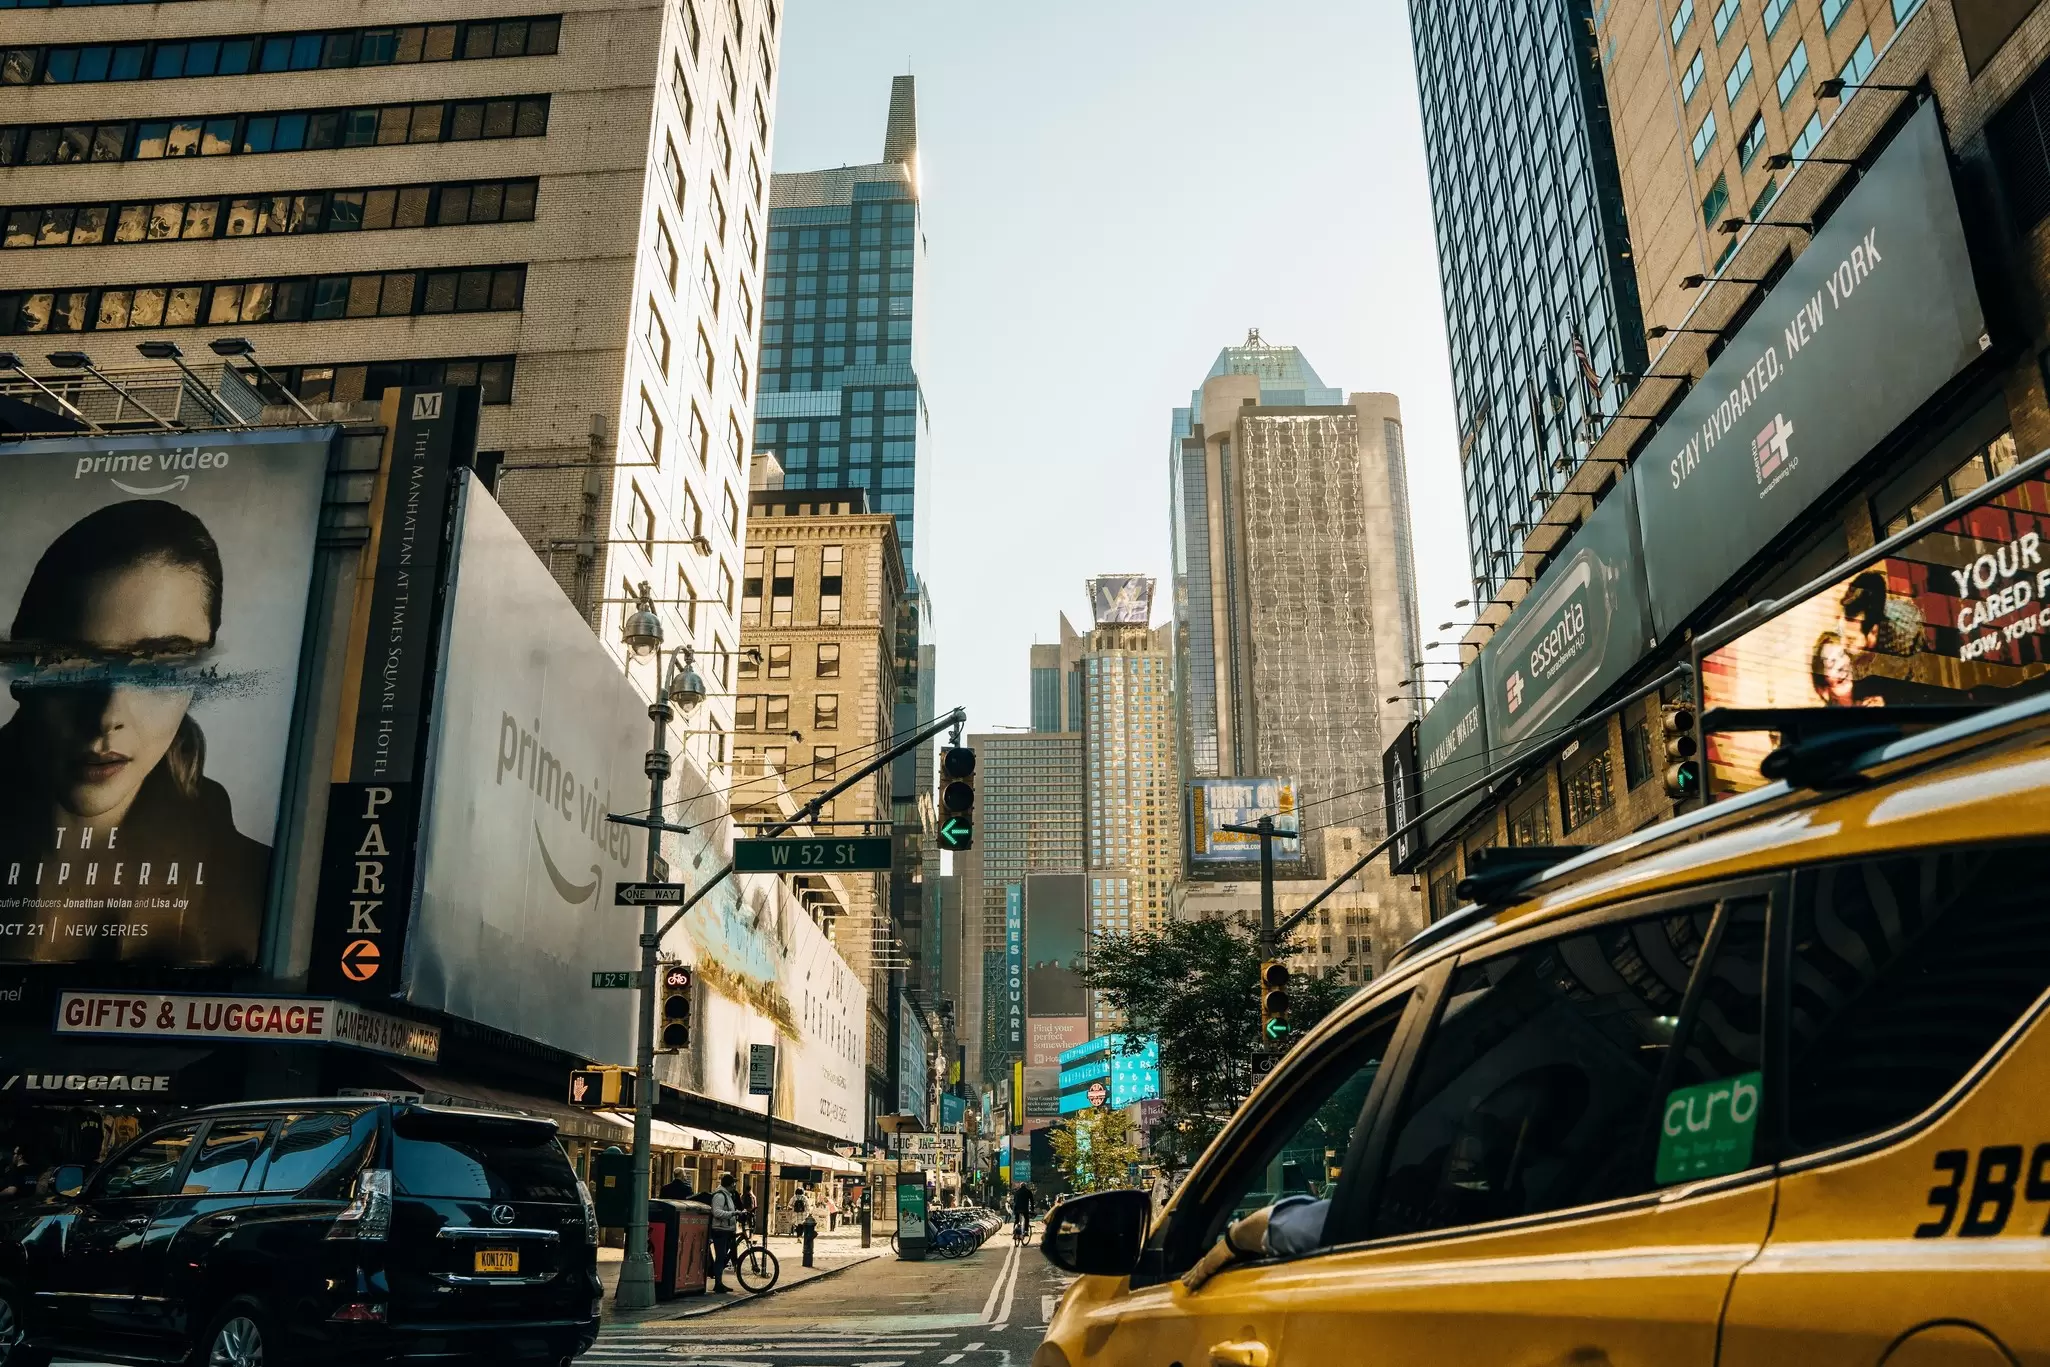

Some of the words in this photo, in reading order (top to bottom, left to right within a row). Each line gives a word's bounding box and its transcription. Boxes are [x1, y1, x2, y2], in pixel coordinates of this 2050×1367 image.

[1670, 431, 1701, 490] STAY
[1702, 346, 1784, 453] HYDRATED,
[1784, 289, 1824, 360] NEW
[1826, 226, 1882, 310] YORK
[414, 429, 430, 459] THE
[75, 450, 152, 479] prime
[159, 447, 229, 472] video
[400, 465, 425, 565] MANHATTAN
[396, 570, 410, 588] AT
[1951, 531, 2042, 599] YOUR
[390, 594, 409, 643] TIMES
[1957, 580, 2032, 634] CARED
[1530, 602, 1585, 678] essentia
[1960, 631, 2002, 663] NOW,
[2003, 613, 2037, 643] YOU
[382, 648, 402, 712] SQUARE
[373, 720, 393, 776] HOTEL
[1429, 730, 1456, 777] ALKALINE
[496, 710, 575, 821] prime
[580, 781, 631, 869] video
[1210, 786, 1254, 809] HURT
[56, 827, 118, 849] THE
[771, 844, 790, 865] W
[801, 844, 824, 865] 52
[835, 844, 856, 865] St
[8, 862, 204, 885] RIPHERAL
[347, 787, 393, 934] PARK
[22, 897, 62, 908] Producers
[63, 897, 104, 909] Jonathan
[107, 898, 132, 909] Nolan
[134, 898, 149, 909] and
[151, 898, 170, 909] Lisa
[172, 898, 189, 910] Joy
[626, 889, 646, 899] ONE
[655, 890, 676, 899] WAY
[27, 923, 44, 936] 21
[65, 924, 98, 937] NEW
[101, 924, 149, 937] SERIES
[1009, 893, 1021, 955] TIMES
[594, 973, 602, 987] W
[604, 973, 616, 987] 52
[618, 973, 627, 981] ST
[65, 998, 147, 1029] GIFTS
[156, 1001, 176, 1029] &
[187, 1002, 325, 1035] LUGGAGE
[1009, 964, 1021, 1042] SQUARE
[335, 1008, 380, 1045] CAMERAS
[1033, 1023, 1053, 1032] Find
[1054, 1025, 1074, 1034] your
[1033, 1032, 1064, 1042] perfect
[26, 1074, 170, 1092] LUGGAGE
[1663, 1080, 1758, 1136] curb
